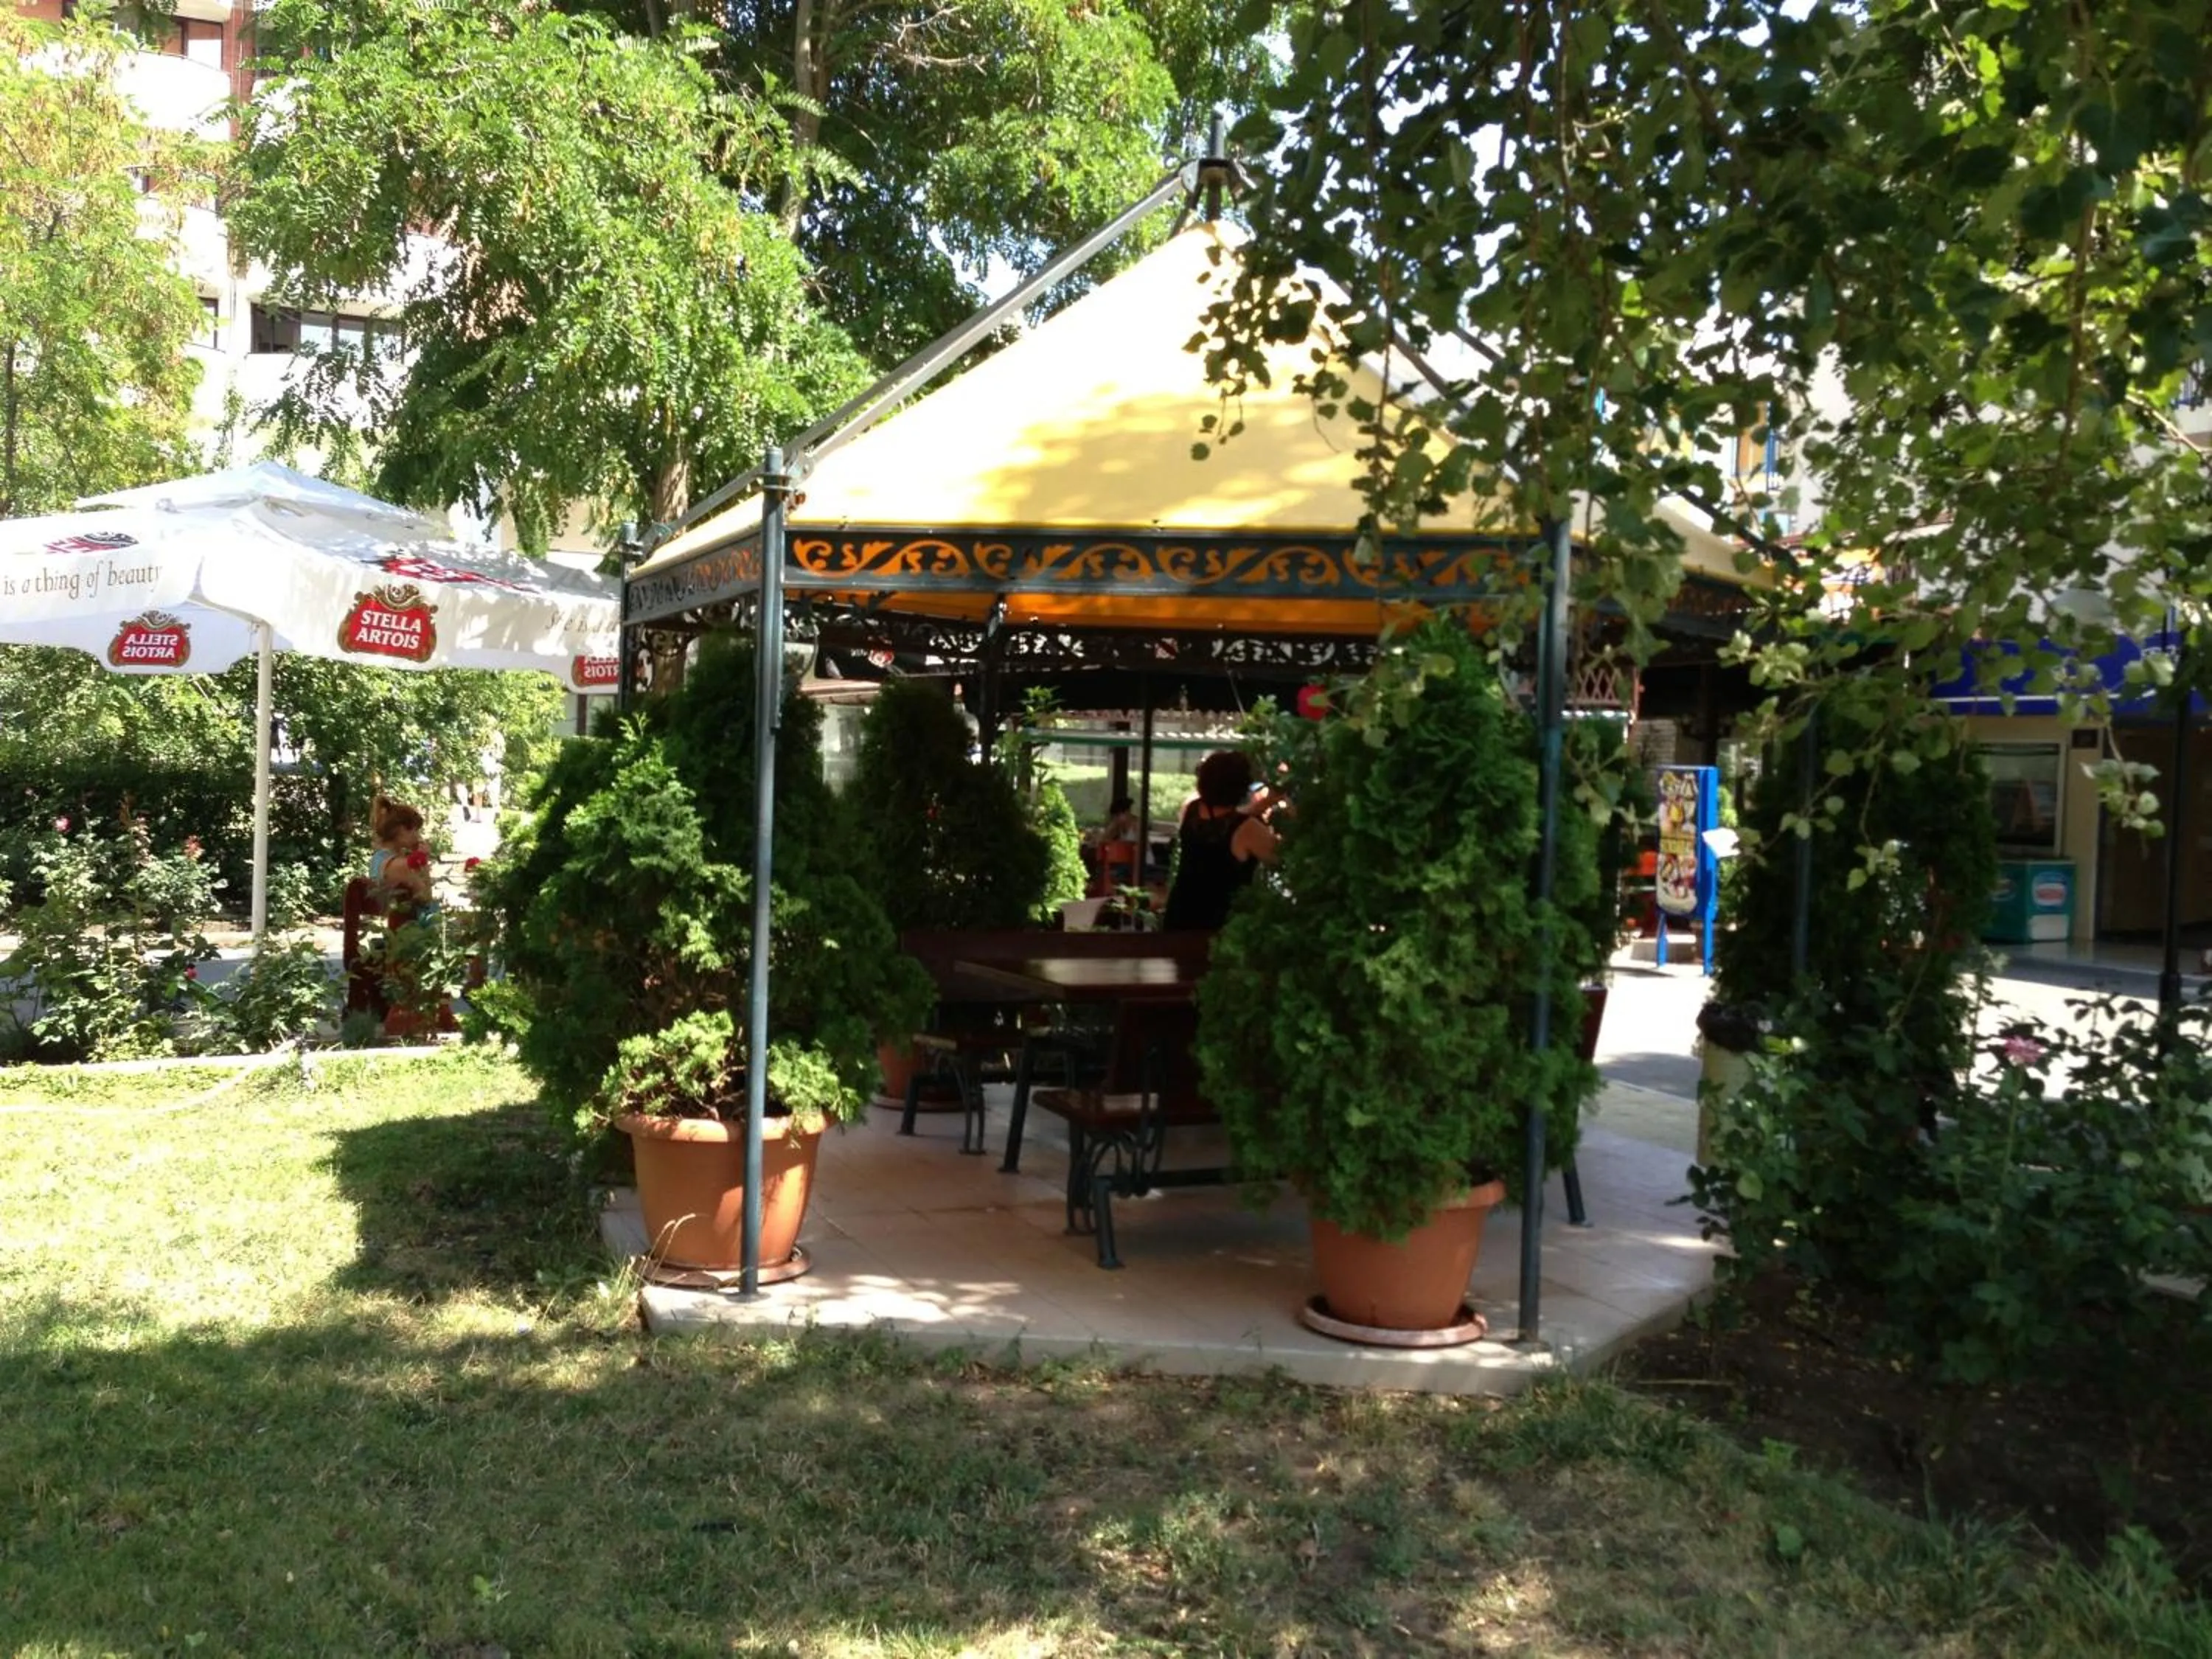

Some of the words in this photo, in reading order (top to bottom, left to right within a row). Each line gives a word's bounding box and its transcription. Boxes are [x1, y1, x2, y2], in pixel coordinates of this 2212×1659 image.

[4, 575, 16, 596] is
[21, 578, 31, 594] a
[35, 566, 80, 600] thing
[86, 560, 104, 598] of
[107, 561, 162, 593] beauty
[361, 609, 422, 633] STELLA
[355, 627, 420, 650] ARTOIS
